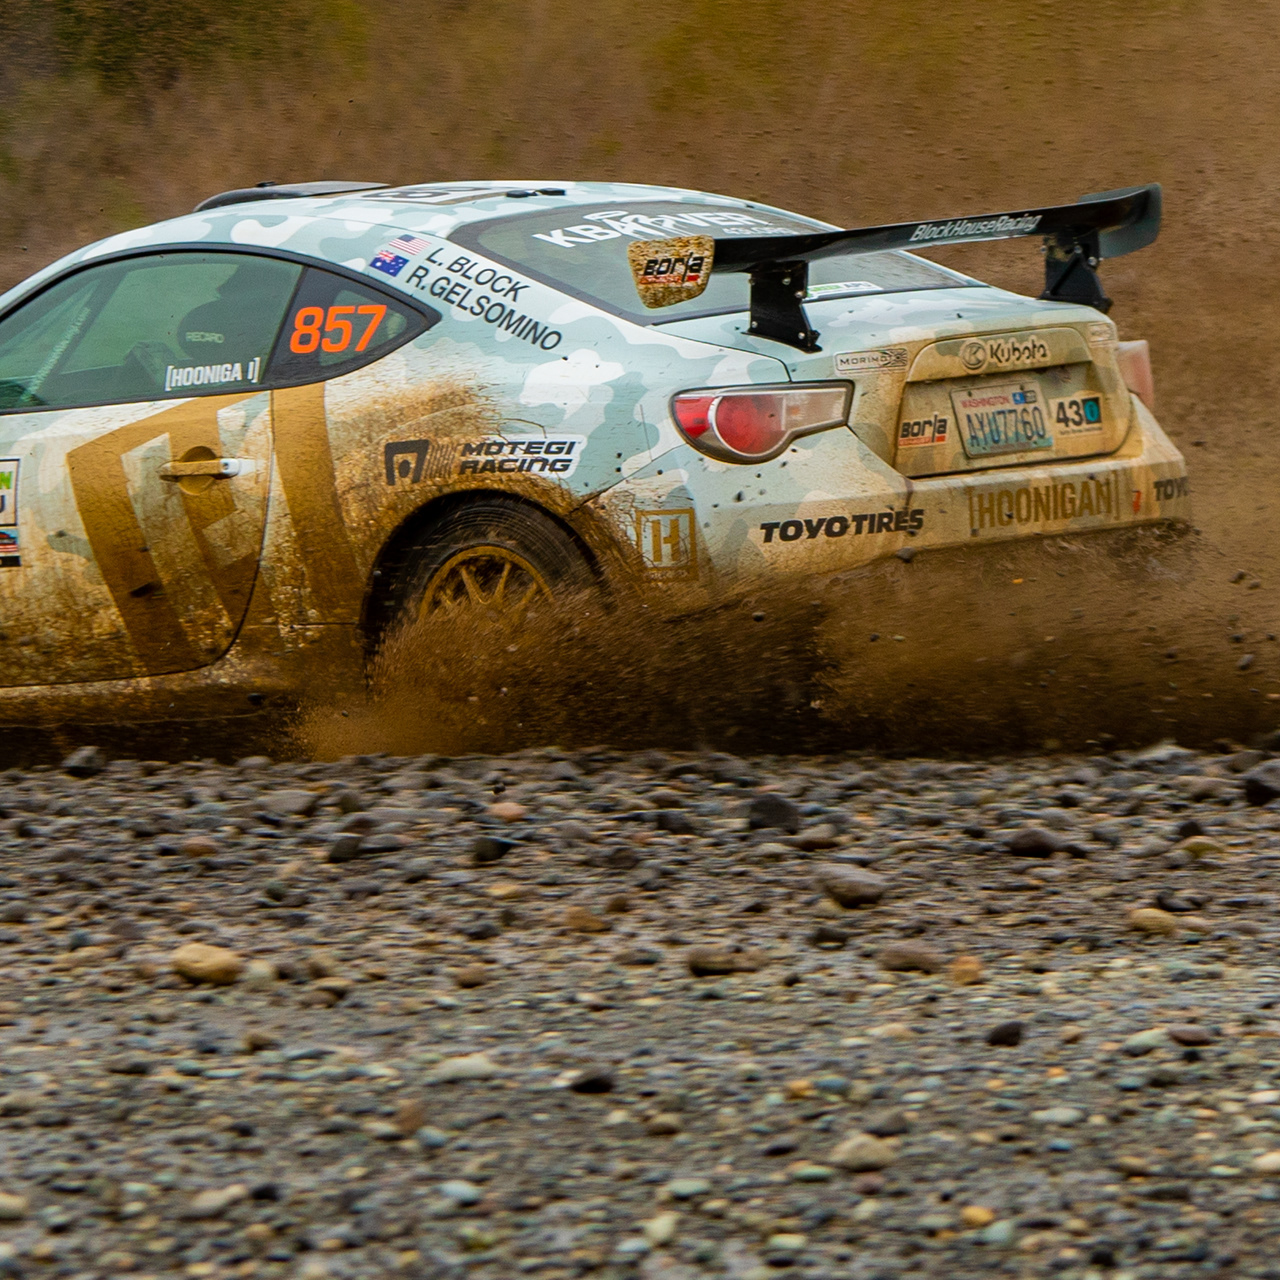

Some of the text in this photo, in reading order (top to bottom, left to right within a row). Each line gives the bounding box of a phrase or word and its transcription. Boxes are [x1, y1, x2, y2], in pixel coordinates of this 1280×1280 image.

[909, 213, 1043, 242] BlockHouseRacing
[426, 247, 530, 303] L. BLOCK
[290, 304, 387, 354] 857
[461, 441, 577, 457] MOTEGI
[459, 459, 574, 474] RACING
[760, 508, 925, 544] TOYO TIRES
